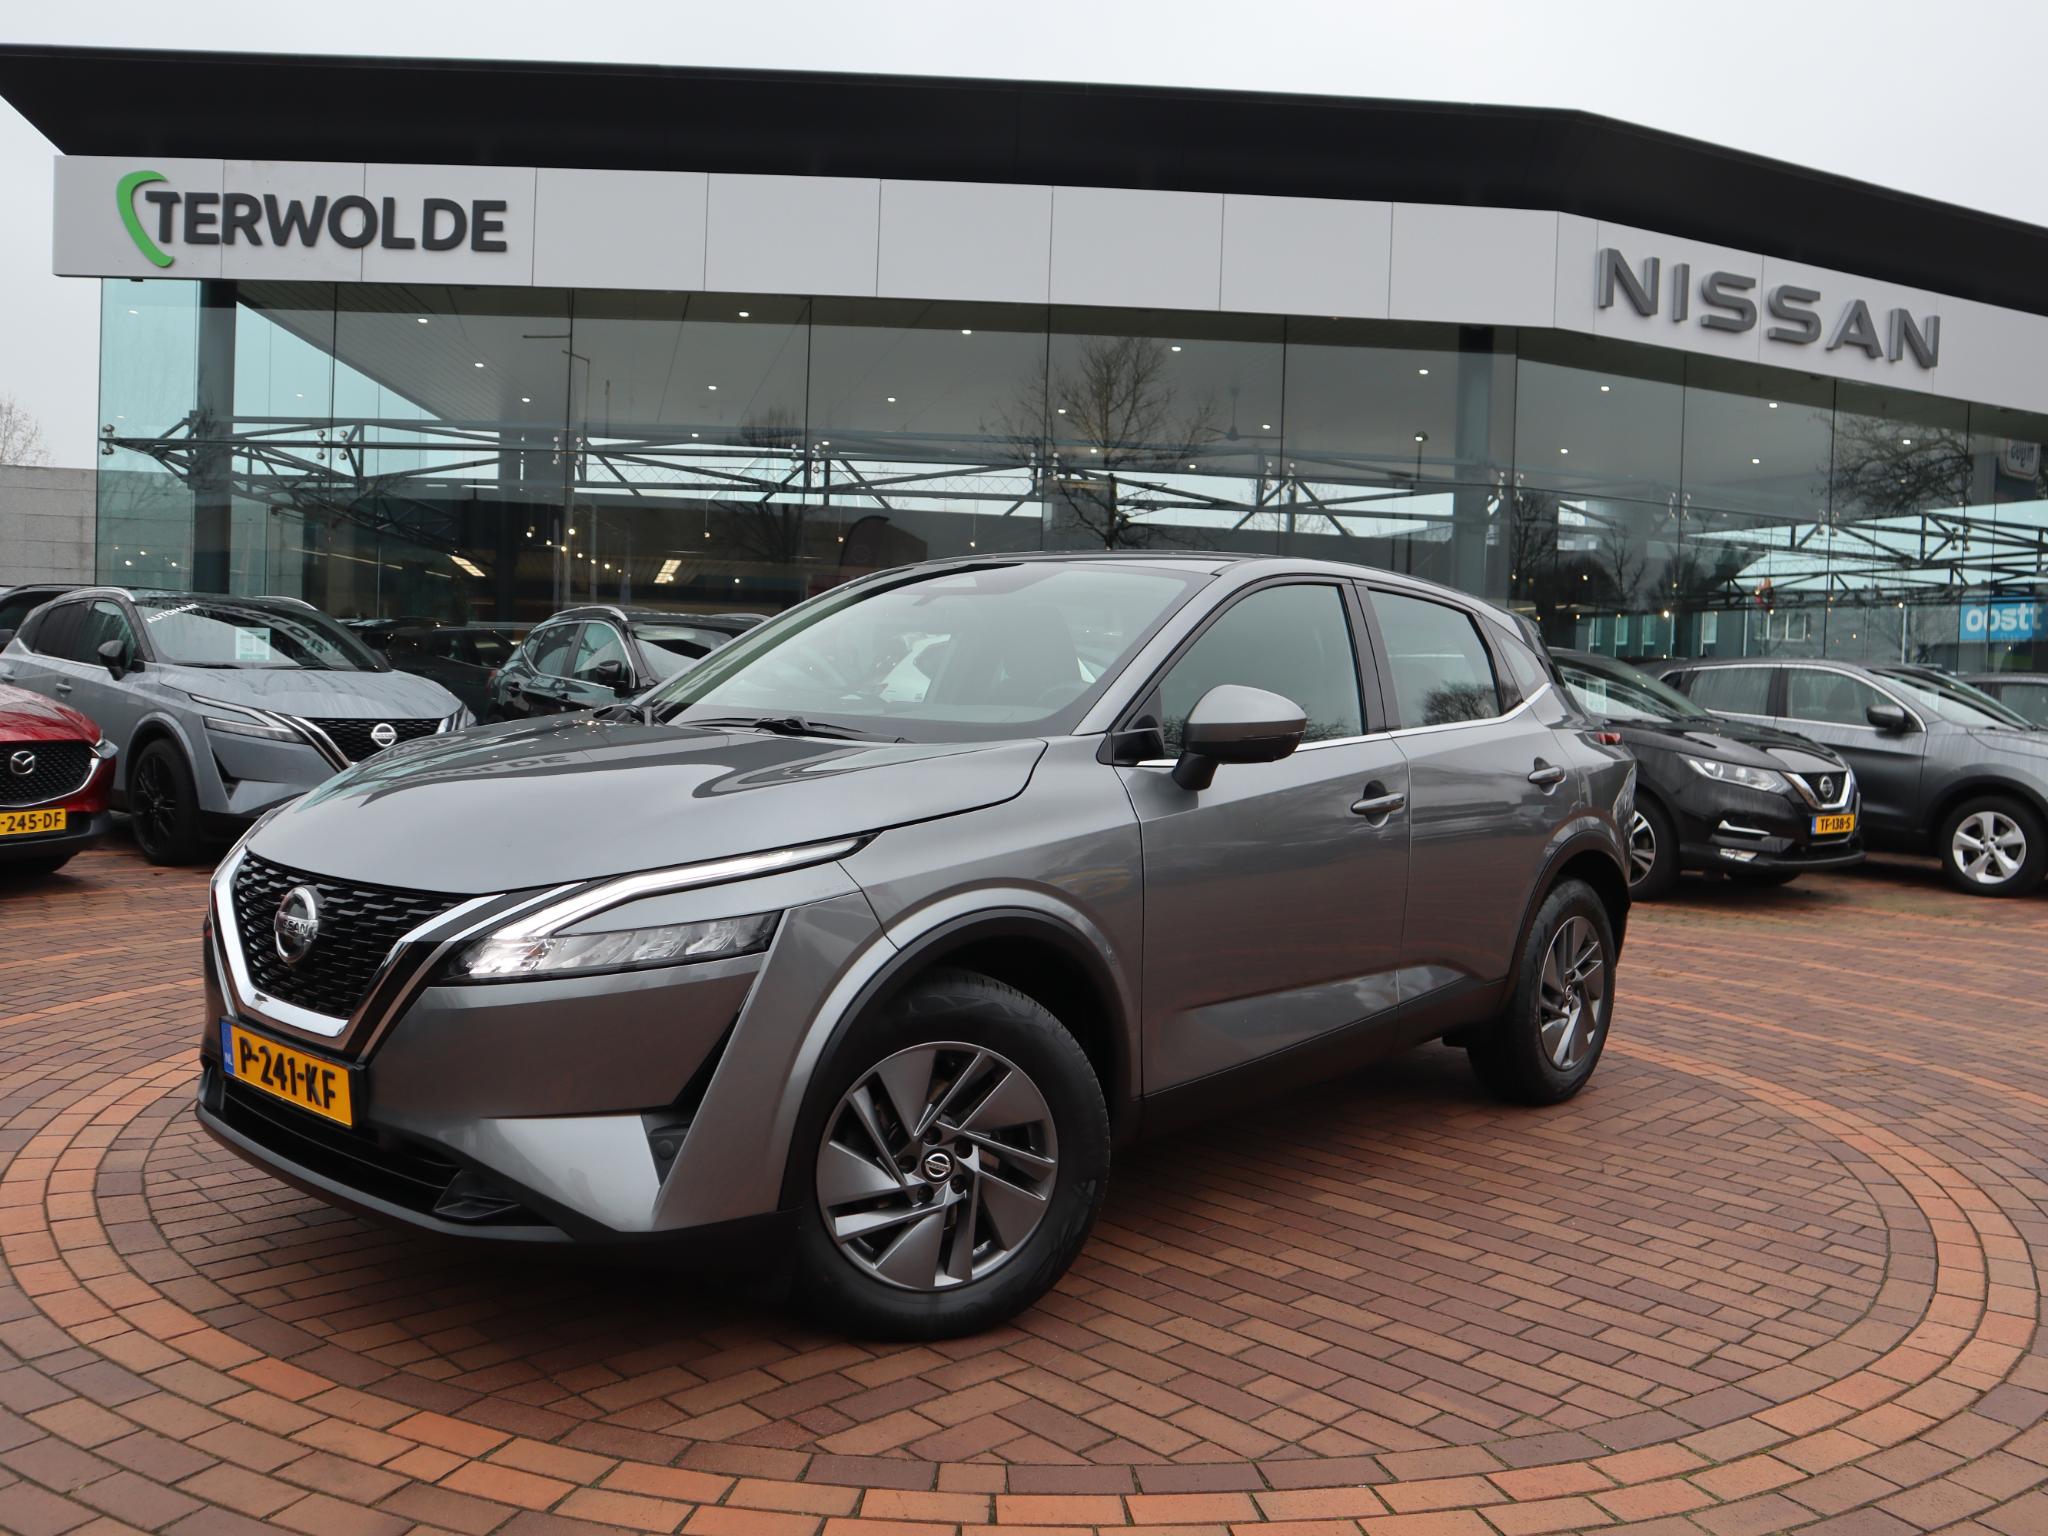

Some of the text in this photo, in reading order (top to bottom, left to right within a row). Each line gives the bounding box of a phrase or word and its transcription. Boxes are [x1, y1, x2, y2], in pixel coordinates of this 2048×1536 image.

[145, 191, 507, 252] TERWOLDE
[1597, 248, 1941, 370] NISSAN
[239, 1036, 336, 1110] P-241-KF
